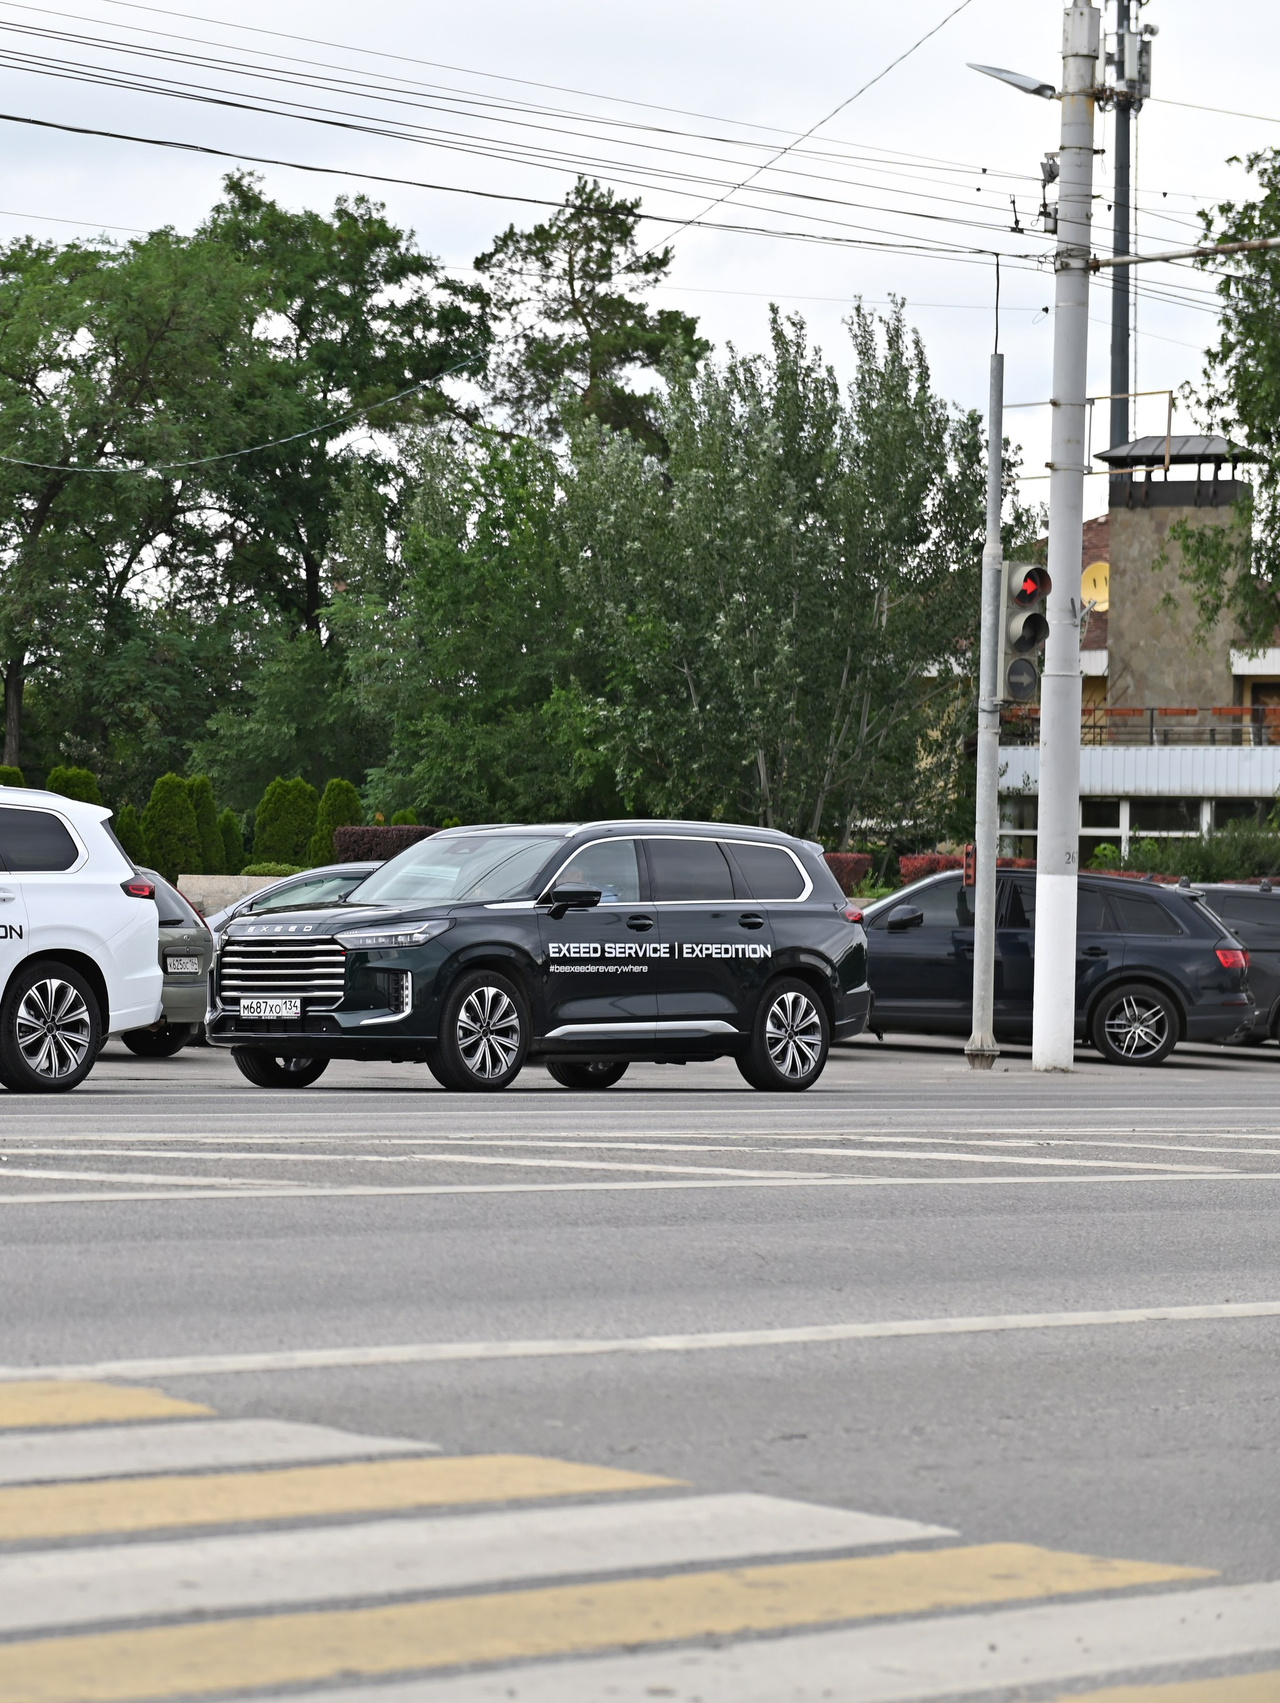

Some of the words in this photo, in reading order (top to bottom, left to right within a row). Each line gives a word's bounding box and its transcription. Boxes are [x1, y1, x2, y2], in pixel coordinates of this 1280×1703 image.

[247, 925, 313, 933] EXEED
[548, 943, 601, 958] EXEED
[604, 943, 670, 958] SERVICE
[682, 944, 772, 959] EXPEDITION
[549, 964, 648, 974] #beexeedereverywhere
[282, 1000, 298, 1011] 134
